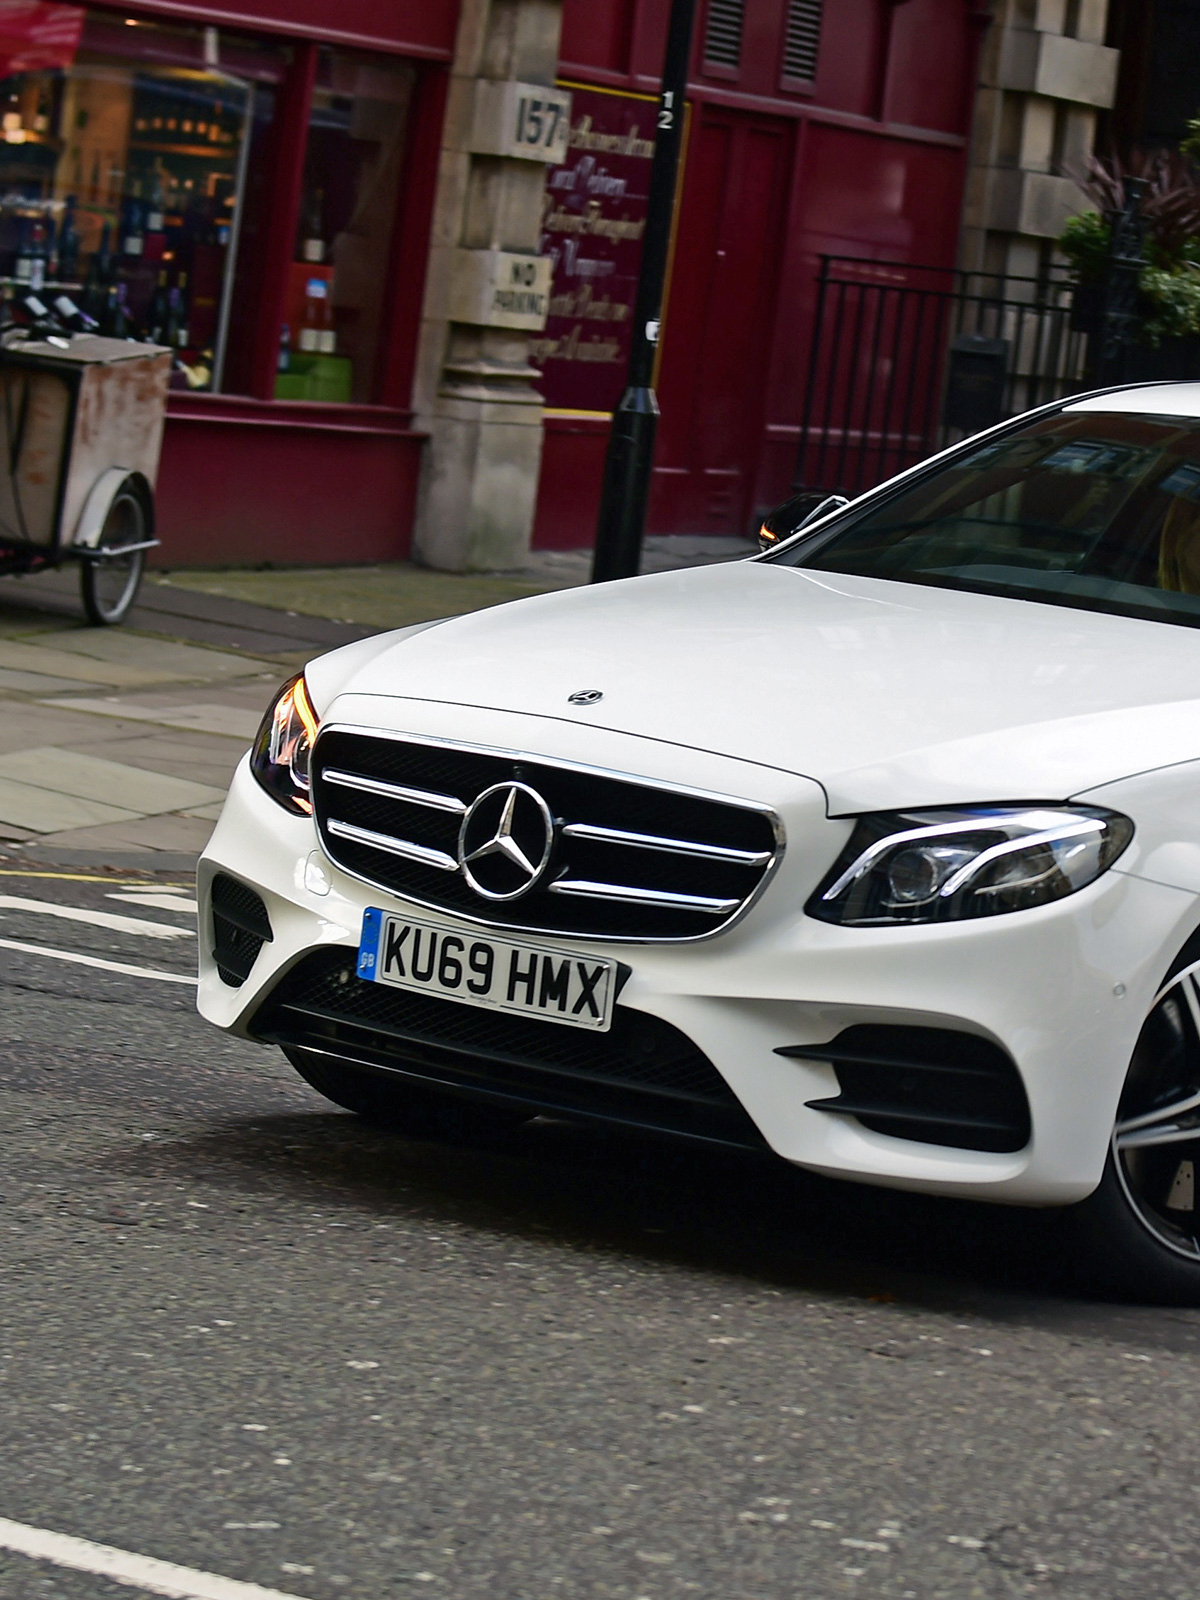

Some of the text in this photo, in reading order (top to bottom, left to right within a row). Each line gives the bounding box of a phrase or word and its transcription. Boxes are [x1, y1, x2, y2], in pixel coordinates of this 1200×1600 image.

[662, 91, 674, 108] 1
[515, 97, 561, 148] 157
[657, 110, 674, 129] 2
[511, 261, 537, 287] NO
[491, 289, 545, 316] PARKING
[361, 951, 375, 967] GB
[384, 921, 605, 1018] KU69 HMX
